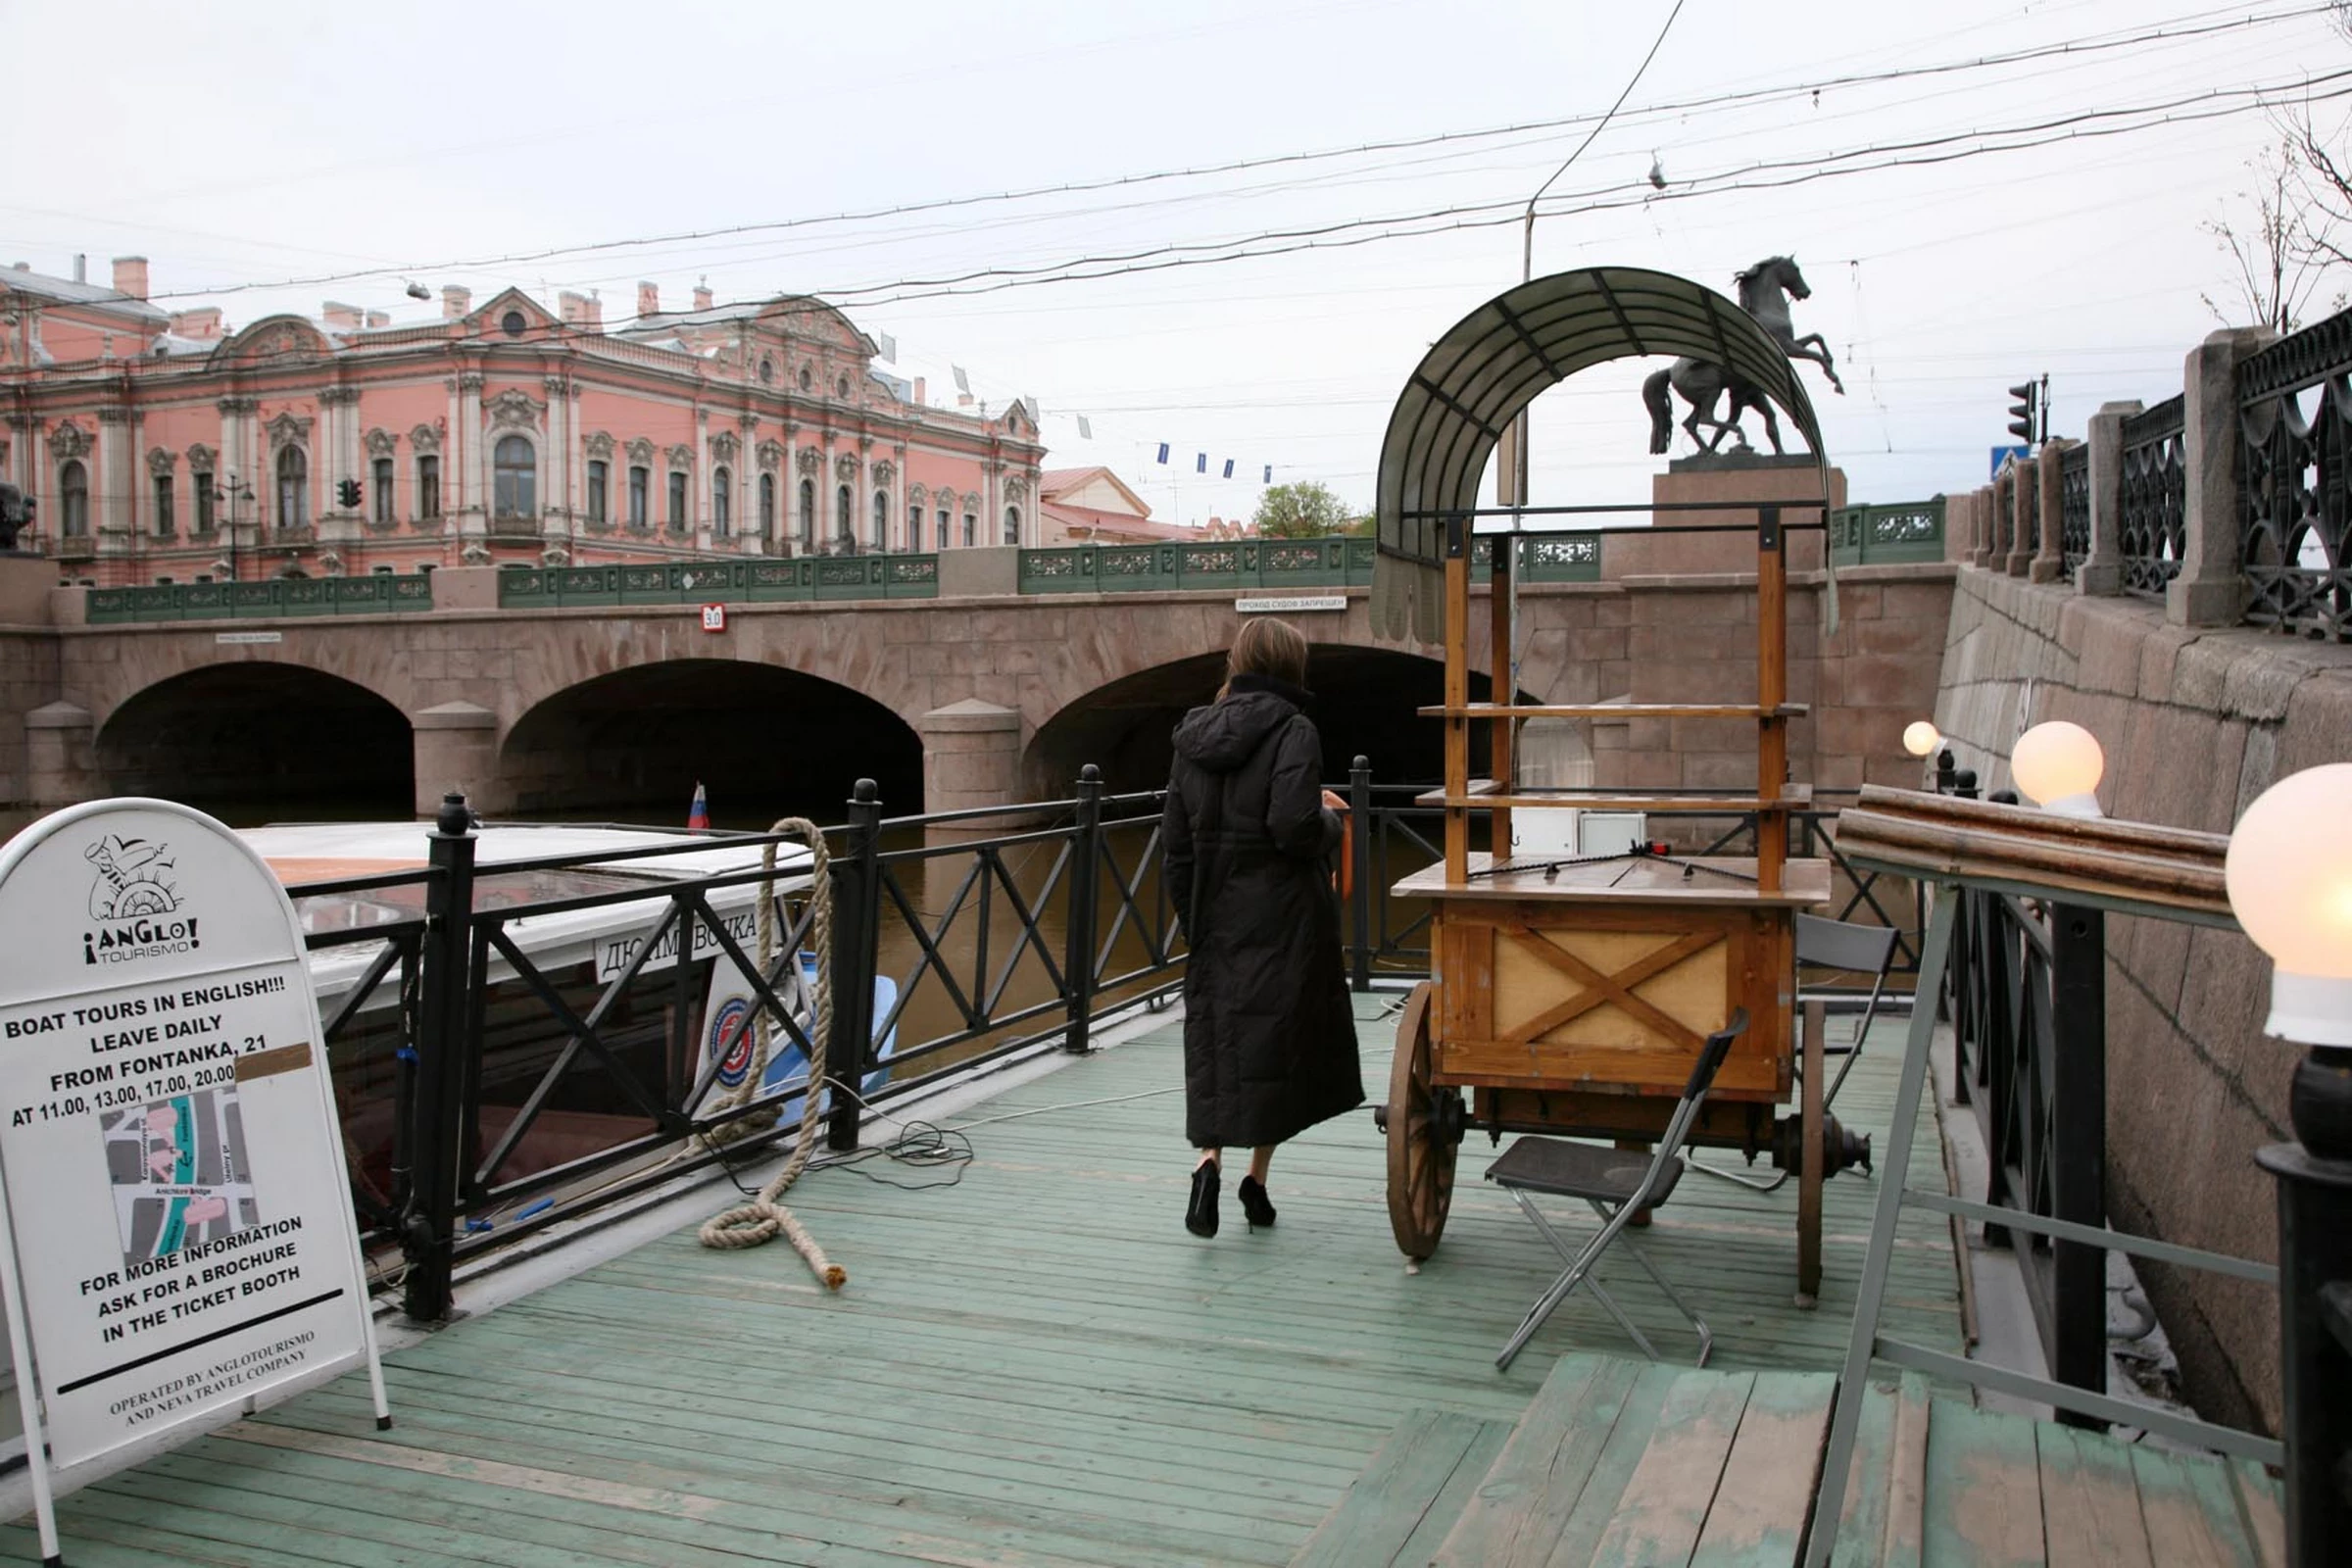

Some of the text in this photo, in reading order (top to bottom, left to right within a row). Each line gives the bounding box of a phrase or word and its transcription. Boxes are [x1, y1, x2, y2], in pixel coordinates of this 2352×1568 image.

[100, 942, 189, 963] TOURISMO
[5, 976, 286, 1039] BOAT TOURS IN ENGLISH!!!
[90, 1015, 222, 1054] LEAVE DAILY
[12, 1065, 235, 1126] AT 11.00, 13.00, 17.00, 20.00
[51, 1035, 267, 1092] FROM FONTANKA, 21
[80, 1273, 121, 1296] FOR
[125, 1254, 179, 1284] MORE
[183, 1216, 303, 1264] INFORMATION
[98, 1243, 297, 1318] ASK FOR A BROCHURE
[103, 1266, 301, 1344] IN THE TICKET BOOTH
[110, 1331, 315, 1416] OPERATED BY ANGLOTOURISMO
[125, 1348, 307, 1428] AND NEVA TRAVEL COMPANY
